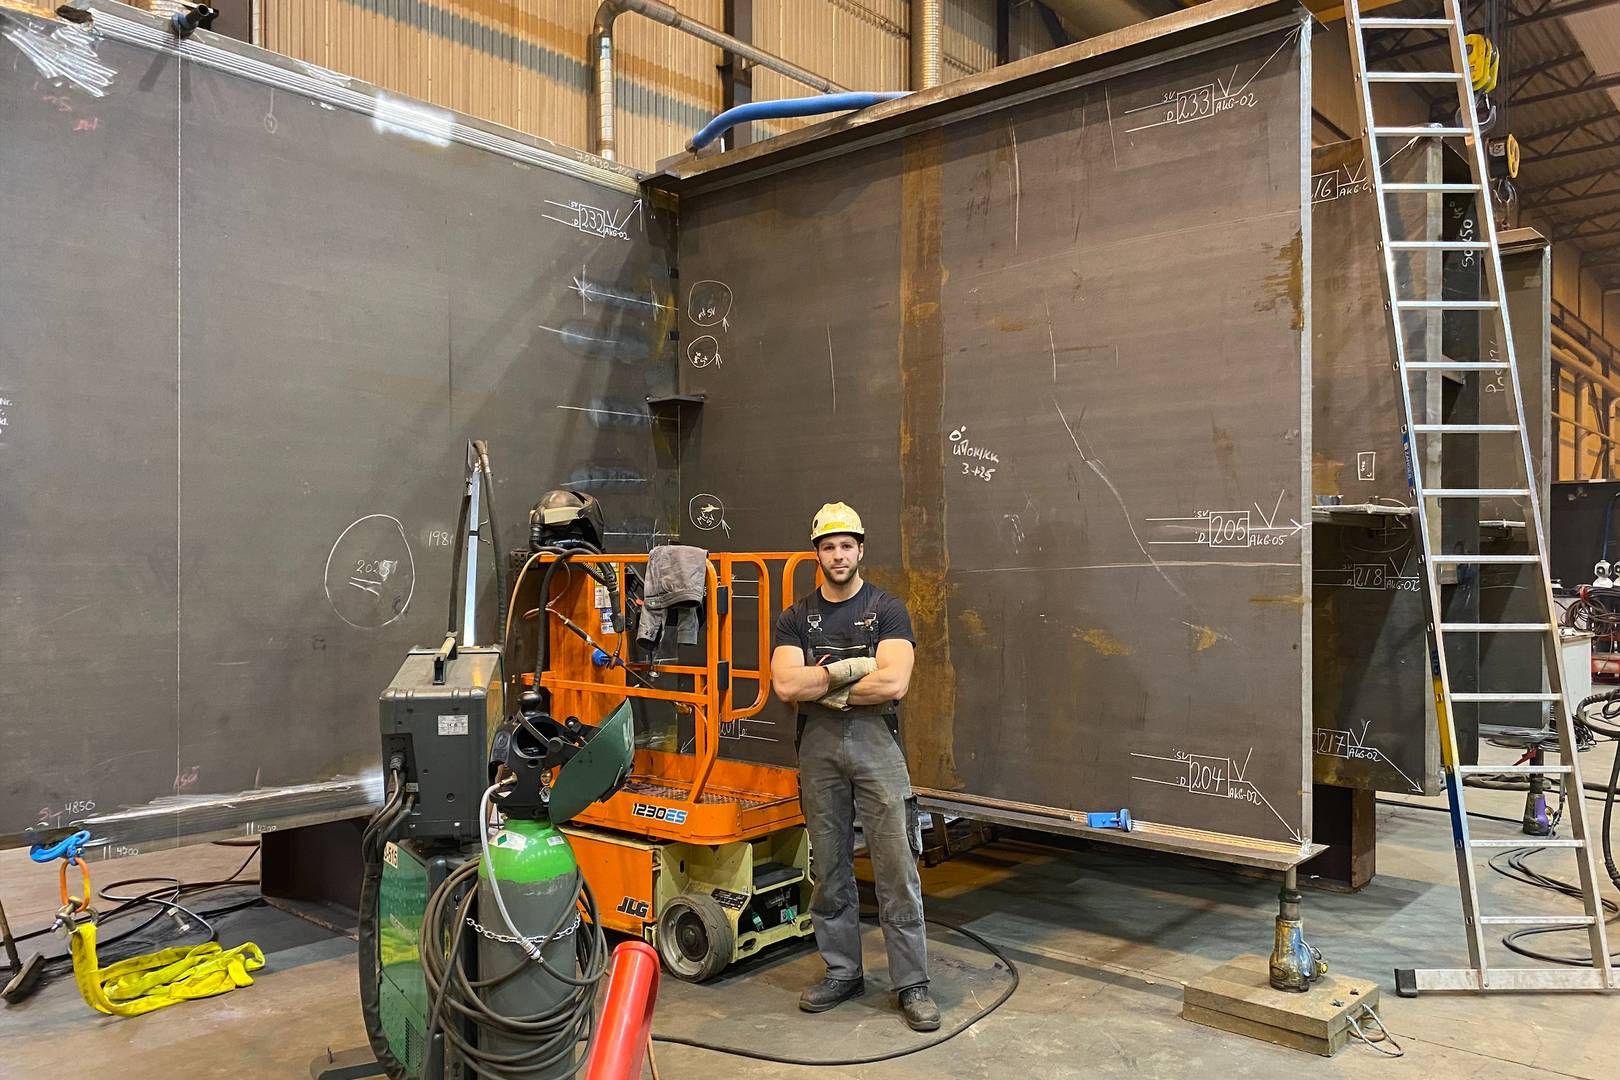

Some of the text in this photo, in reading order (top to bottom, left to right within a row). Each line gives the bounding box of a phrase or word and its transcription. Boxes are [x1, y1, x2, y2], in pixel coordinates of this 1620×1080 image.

[1179, 89, 1209, 119] 233
[1311, 177, 1333, 199] 16
[581, 207, 604, 234] 232
[1211, 515, 1248, 545] 205
[1355, 567, 1383, 587] 218
[1319, 732, 1346, 753] 217
[1190, 761, 1226, 793] 204
[64, 799, 96, 815] 4850
[632, 802, 688, 824] 1230ES
[616, 896, 649, 919] JLG
